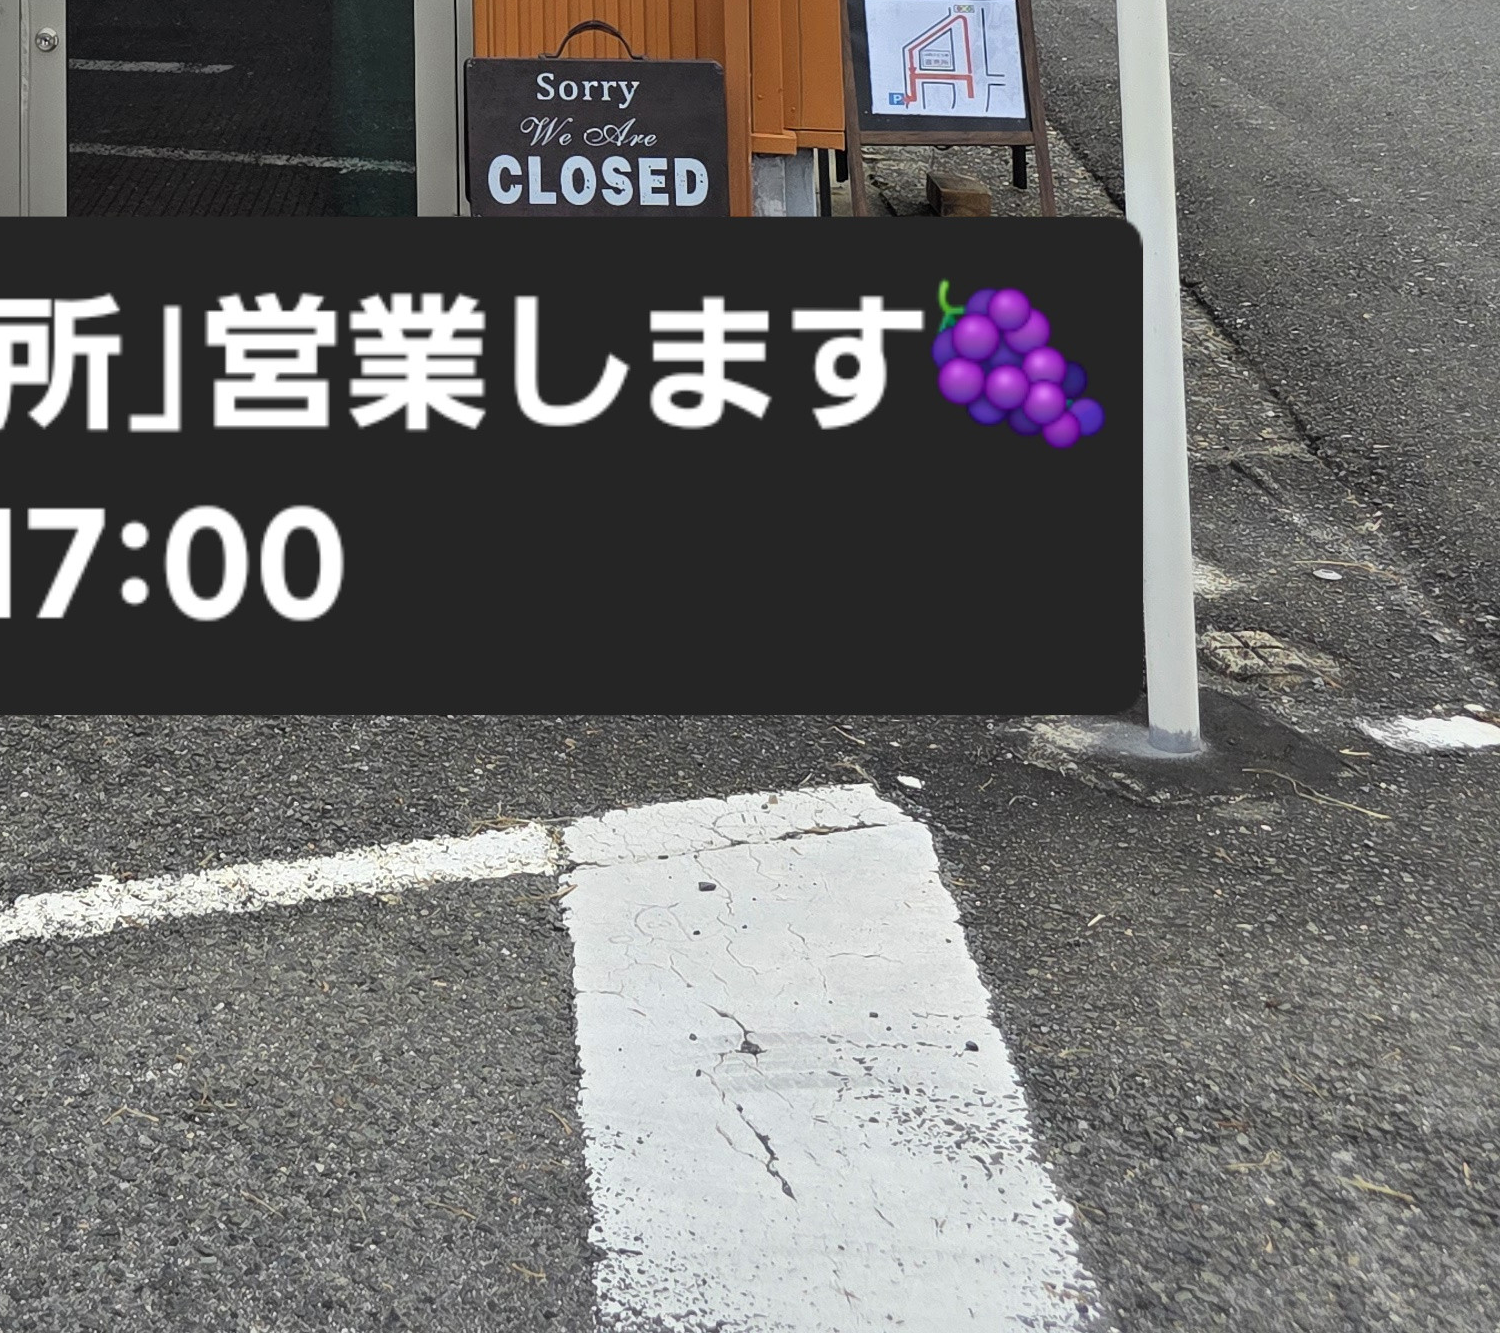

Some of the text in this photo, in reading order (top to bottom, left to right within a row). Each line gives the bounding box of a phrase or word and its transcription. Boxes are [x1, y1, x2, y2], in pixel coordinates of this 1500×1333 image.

[536, 72, 640, 110] Sorry
[520, 118, 658, 147] We Are
[487, 154, 710, 207] CLOSED
